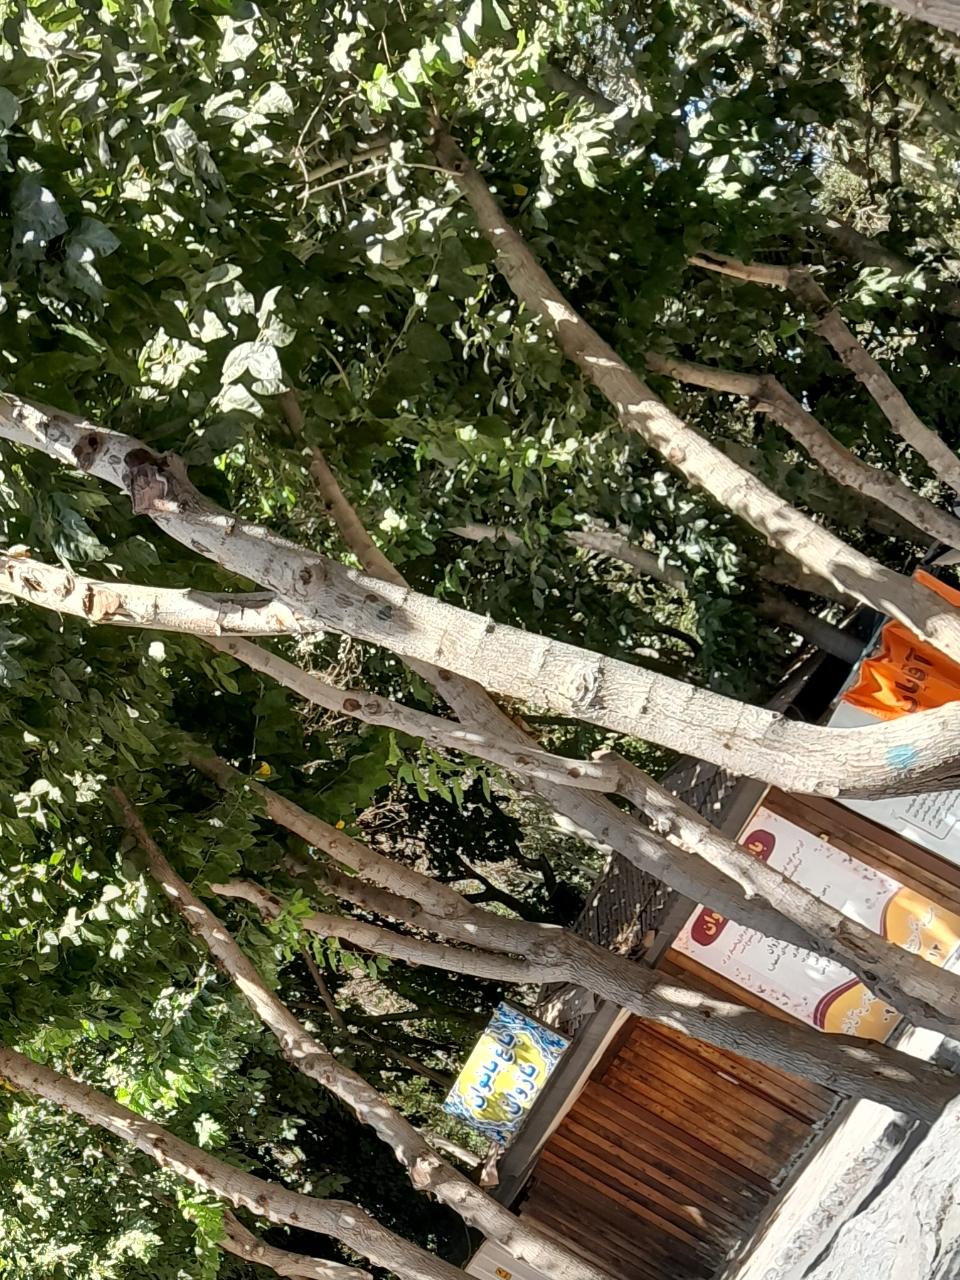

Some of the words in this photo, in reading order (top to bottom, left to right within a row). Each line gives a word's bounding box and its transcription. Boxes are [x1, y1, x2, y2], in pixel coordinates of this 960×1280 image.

[488, 1030, 523, 1062] باغ
[470, 1060, 508, 1109] بانوان
[500, 1063, 537, 1116] ناژوان
